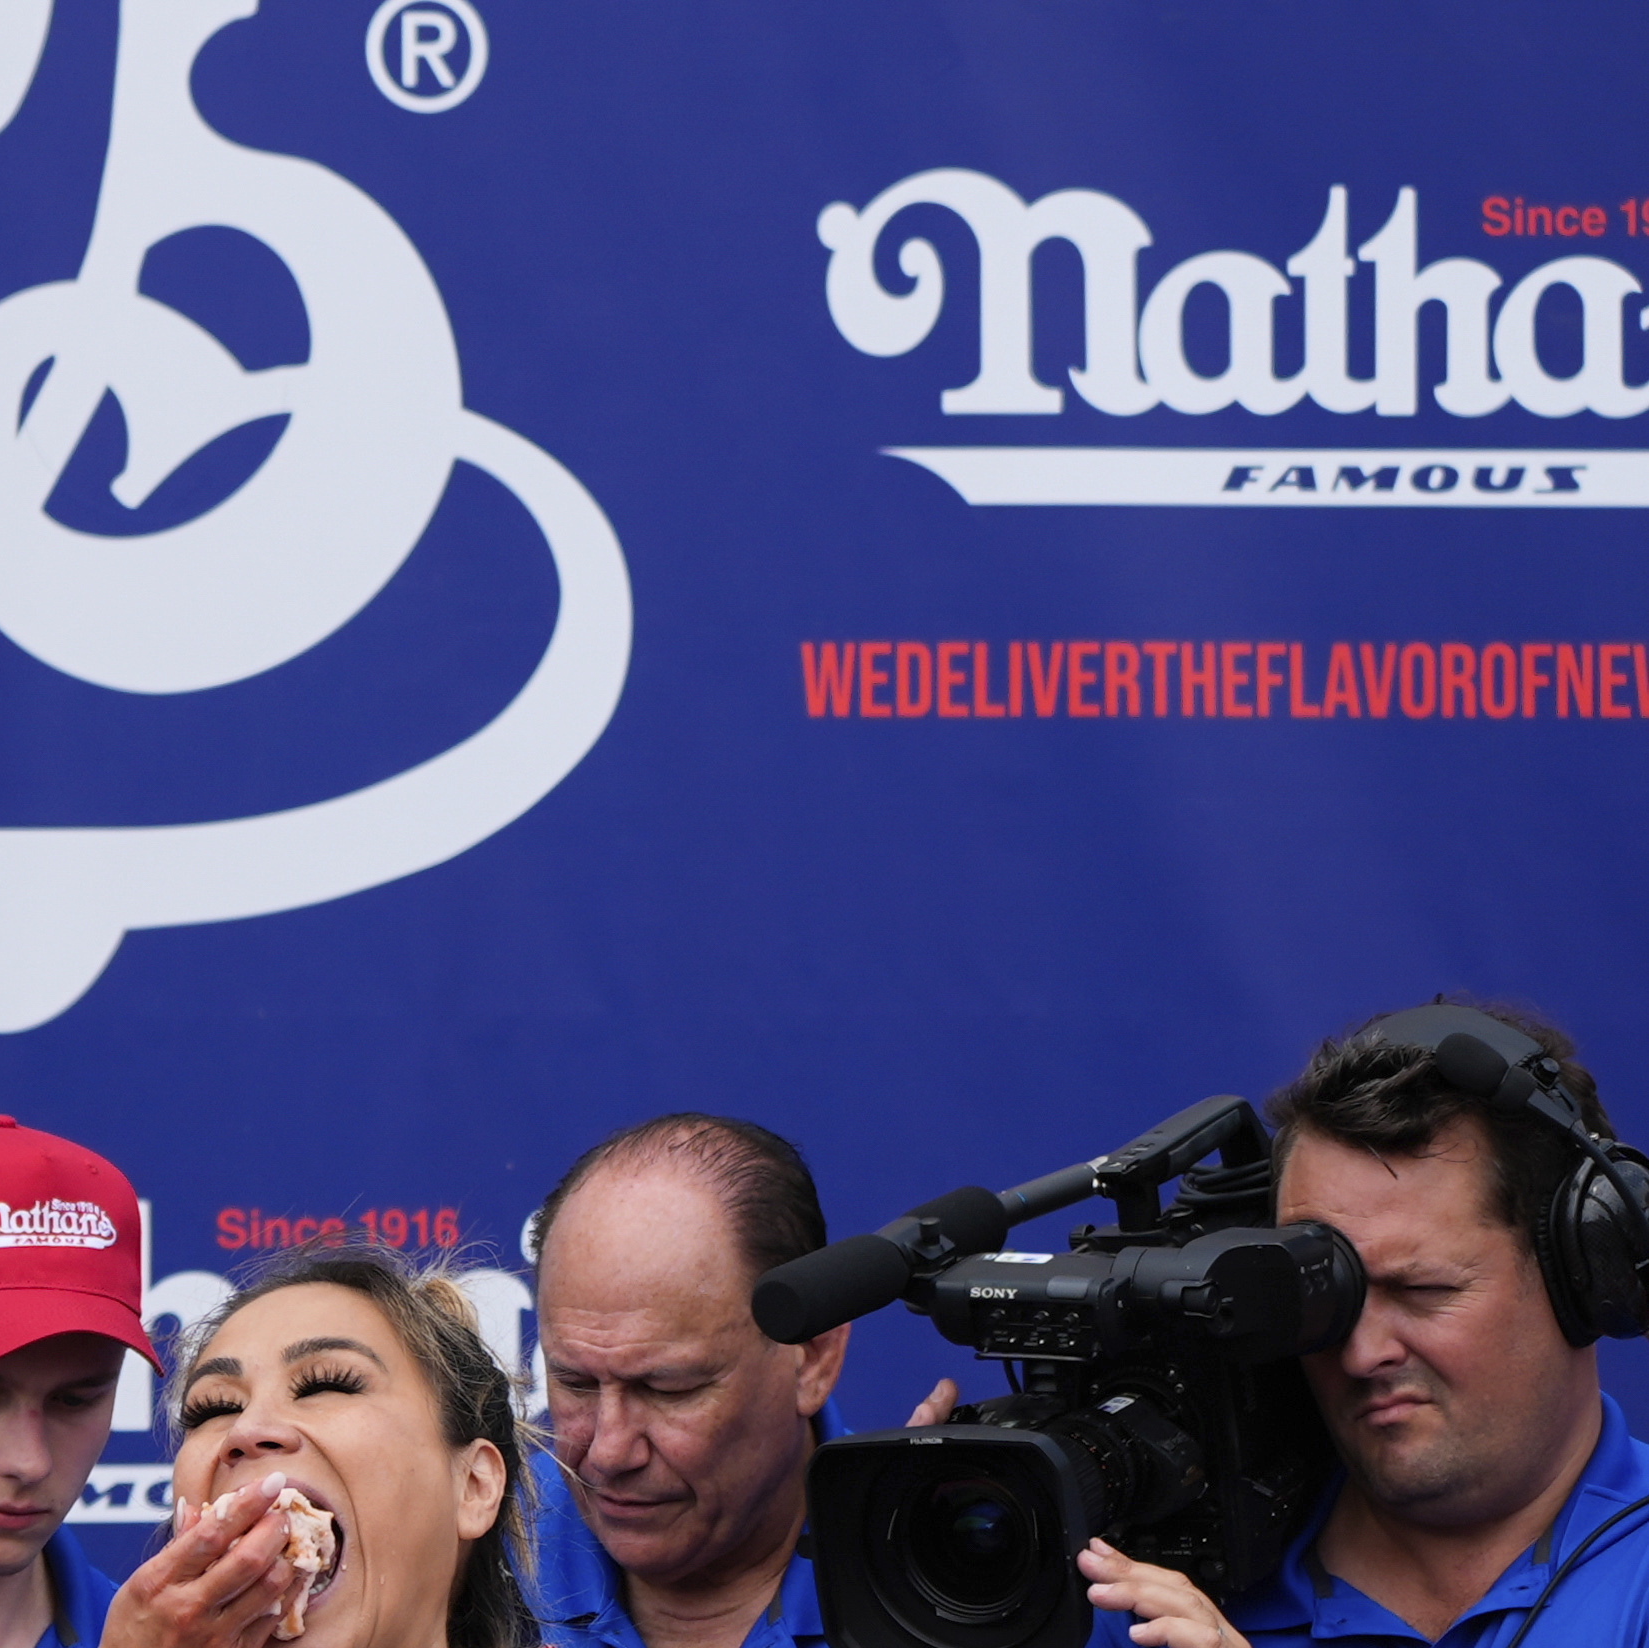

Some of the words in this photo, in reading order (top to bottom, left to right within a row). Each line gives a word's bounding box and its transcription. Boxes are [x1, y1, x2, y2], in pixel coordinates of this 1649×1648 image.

[1481, 196, 1607, 237] Since
[815, 166, 1649, 419] Natha
[1220, 465, 1590, 495] FAMOUS
[216, 1208, 346, 1249] Since
[359, 1208, 459, 1249] 1916
[969, 1287, 1019, 1300] SONY
